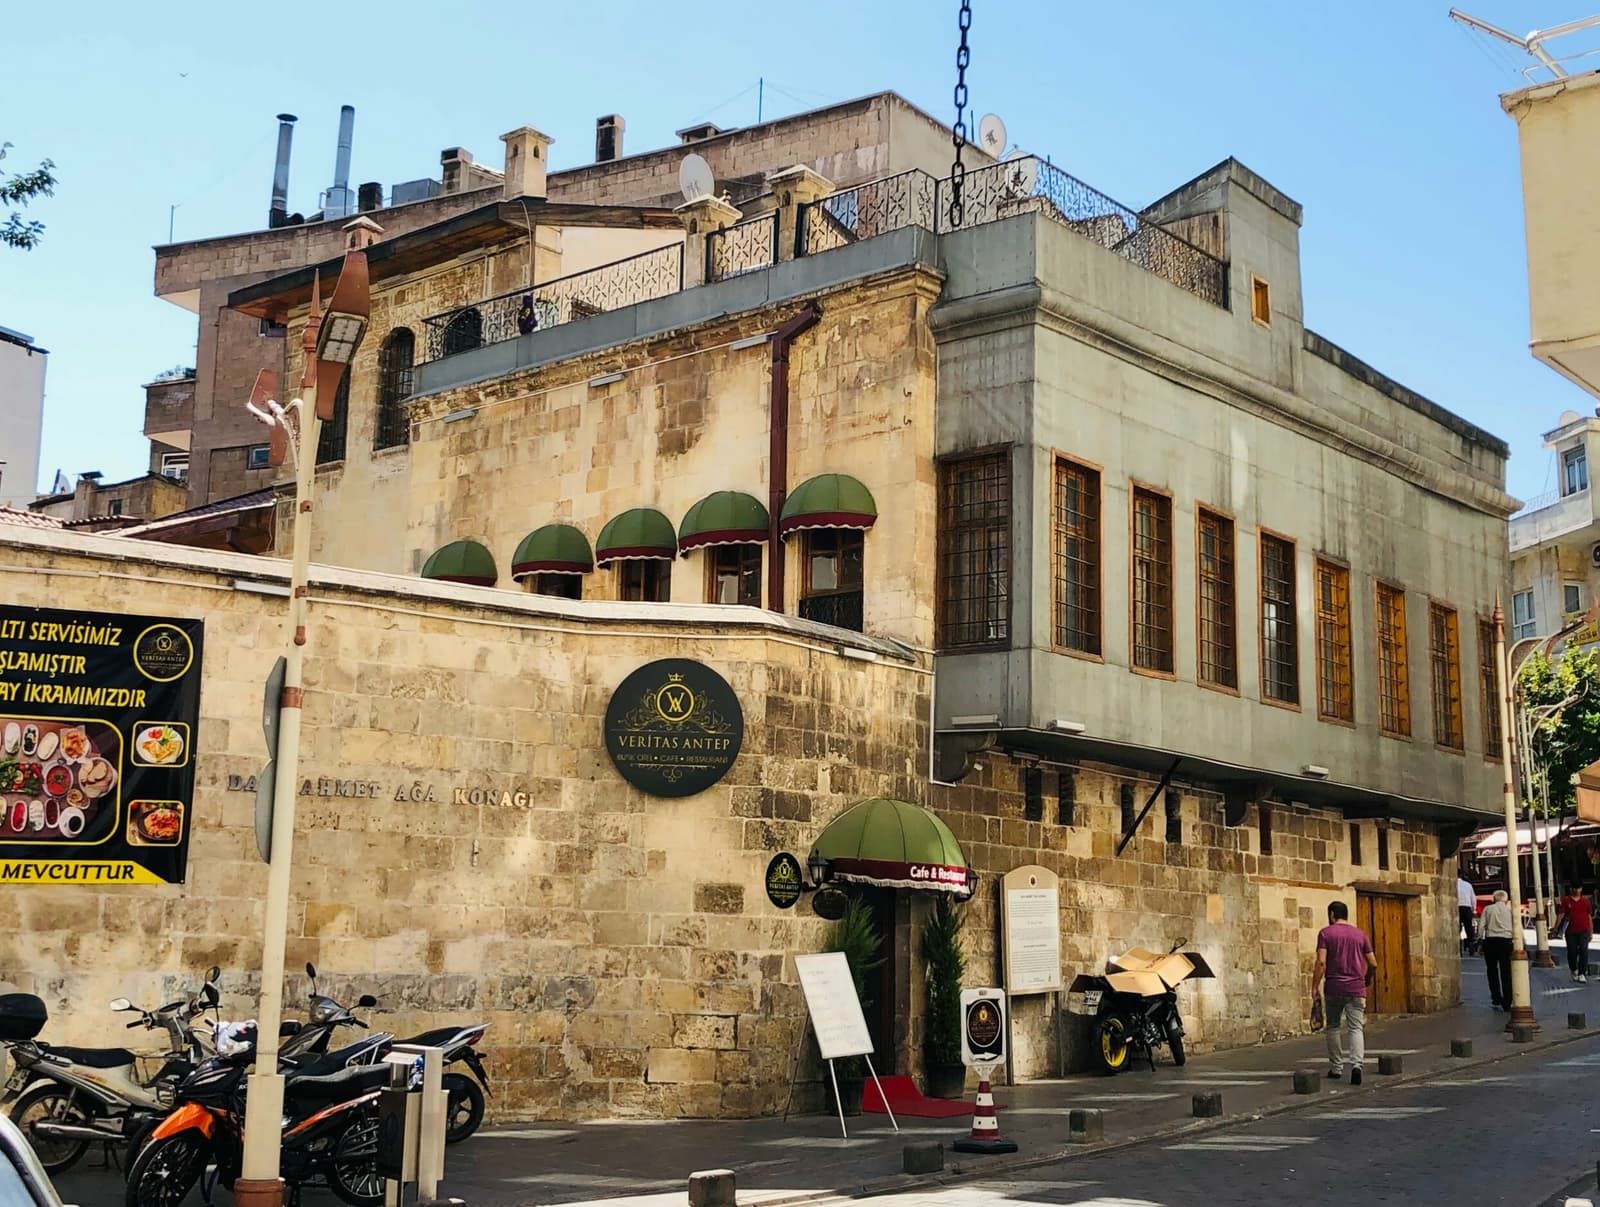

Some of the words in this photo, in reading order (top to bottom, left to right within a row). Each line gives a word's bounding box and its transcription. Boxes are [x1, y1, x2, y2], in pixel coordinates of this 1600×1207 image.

[29, 620, 122, 647] SERVİSİMİZ
[24, 678, 147, 708] İKRAMIMIZDIR
[618, 735, 679, 749] VERİTAS
[682, 738, 730, 751] ANTEP
[299, 778, 381, 799] AHMET
[394, 781, 439, 802] AĞA
[453, 786, 534, 808] KONAĞI
[2, 863, 135, 880] MEVCUTTUR
[910, 865, 930, 879] Cafe
